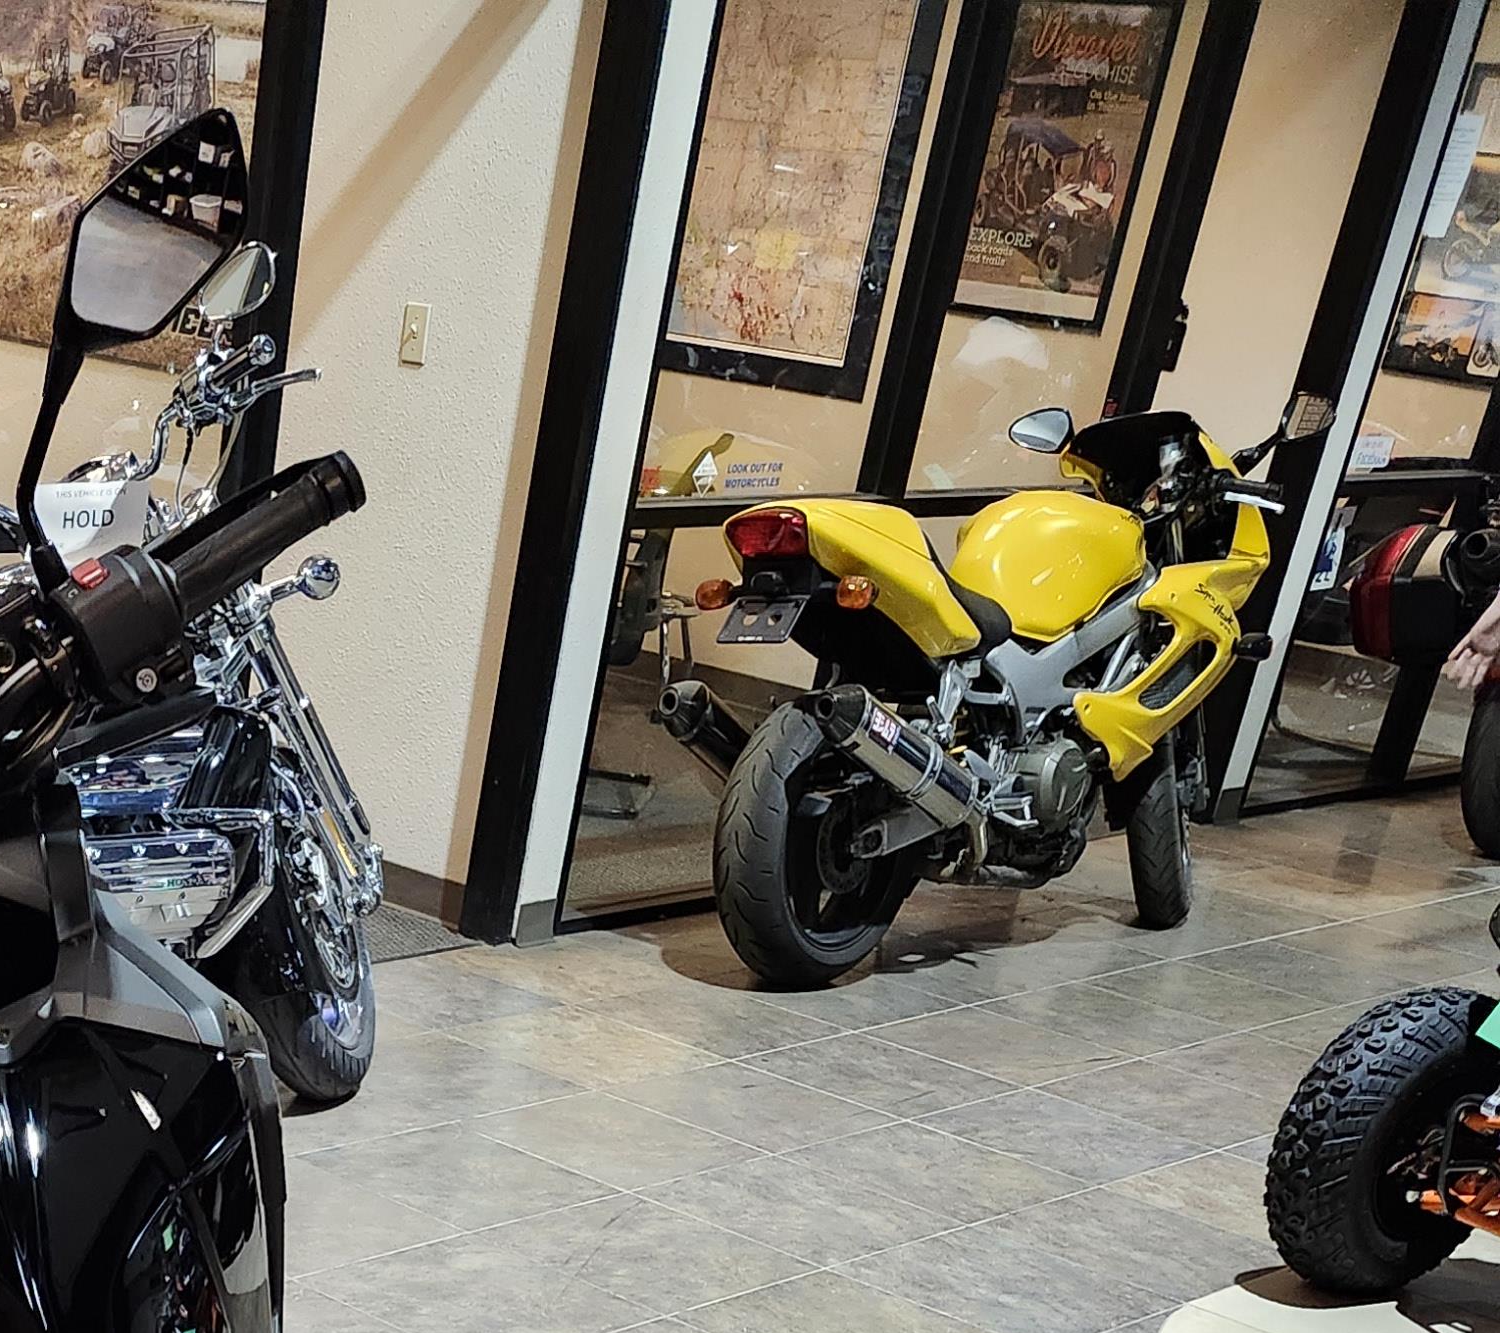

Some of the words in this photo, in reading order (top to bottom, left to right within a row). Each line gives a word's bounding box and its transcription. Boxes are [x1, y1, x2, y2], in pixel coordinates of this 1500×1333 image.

[969, 227, 1034, 248] EXPLORE
[727, 464, 748, 474] LOOK
[750, 463, 766, 473] OUT
[767, 462, 783, 472] FOR
[725, 477, 780, 488] MOTORCYCLES
[63, 509, 115, 529] HOLD
